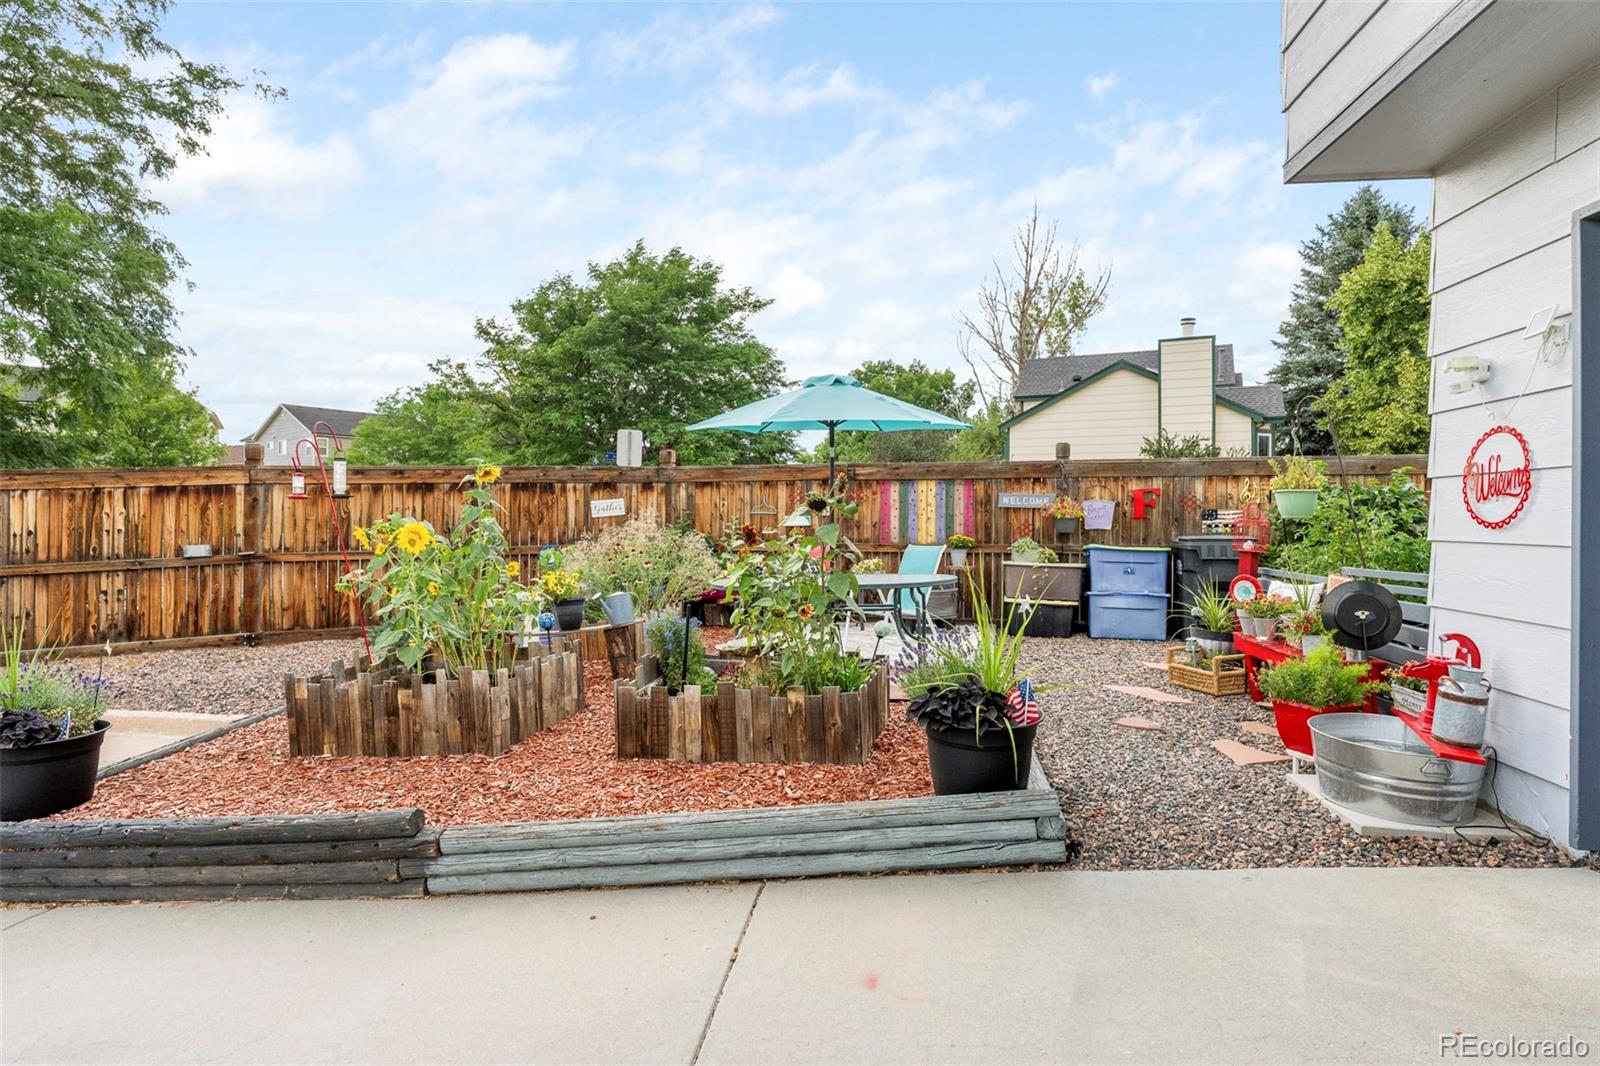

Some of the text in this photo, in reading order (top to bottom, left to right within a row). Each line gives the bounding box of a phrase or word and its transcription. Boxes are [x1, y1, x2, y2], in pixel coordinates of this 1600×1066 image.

[1467, 454, 1529, 503] Welcome
[1002, 495, 1050, 506] WELCOME
[1131, 488, 1161, 520] F
